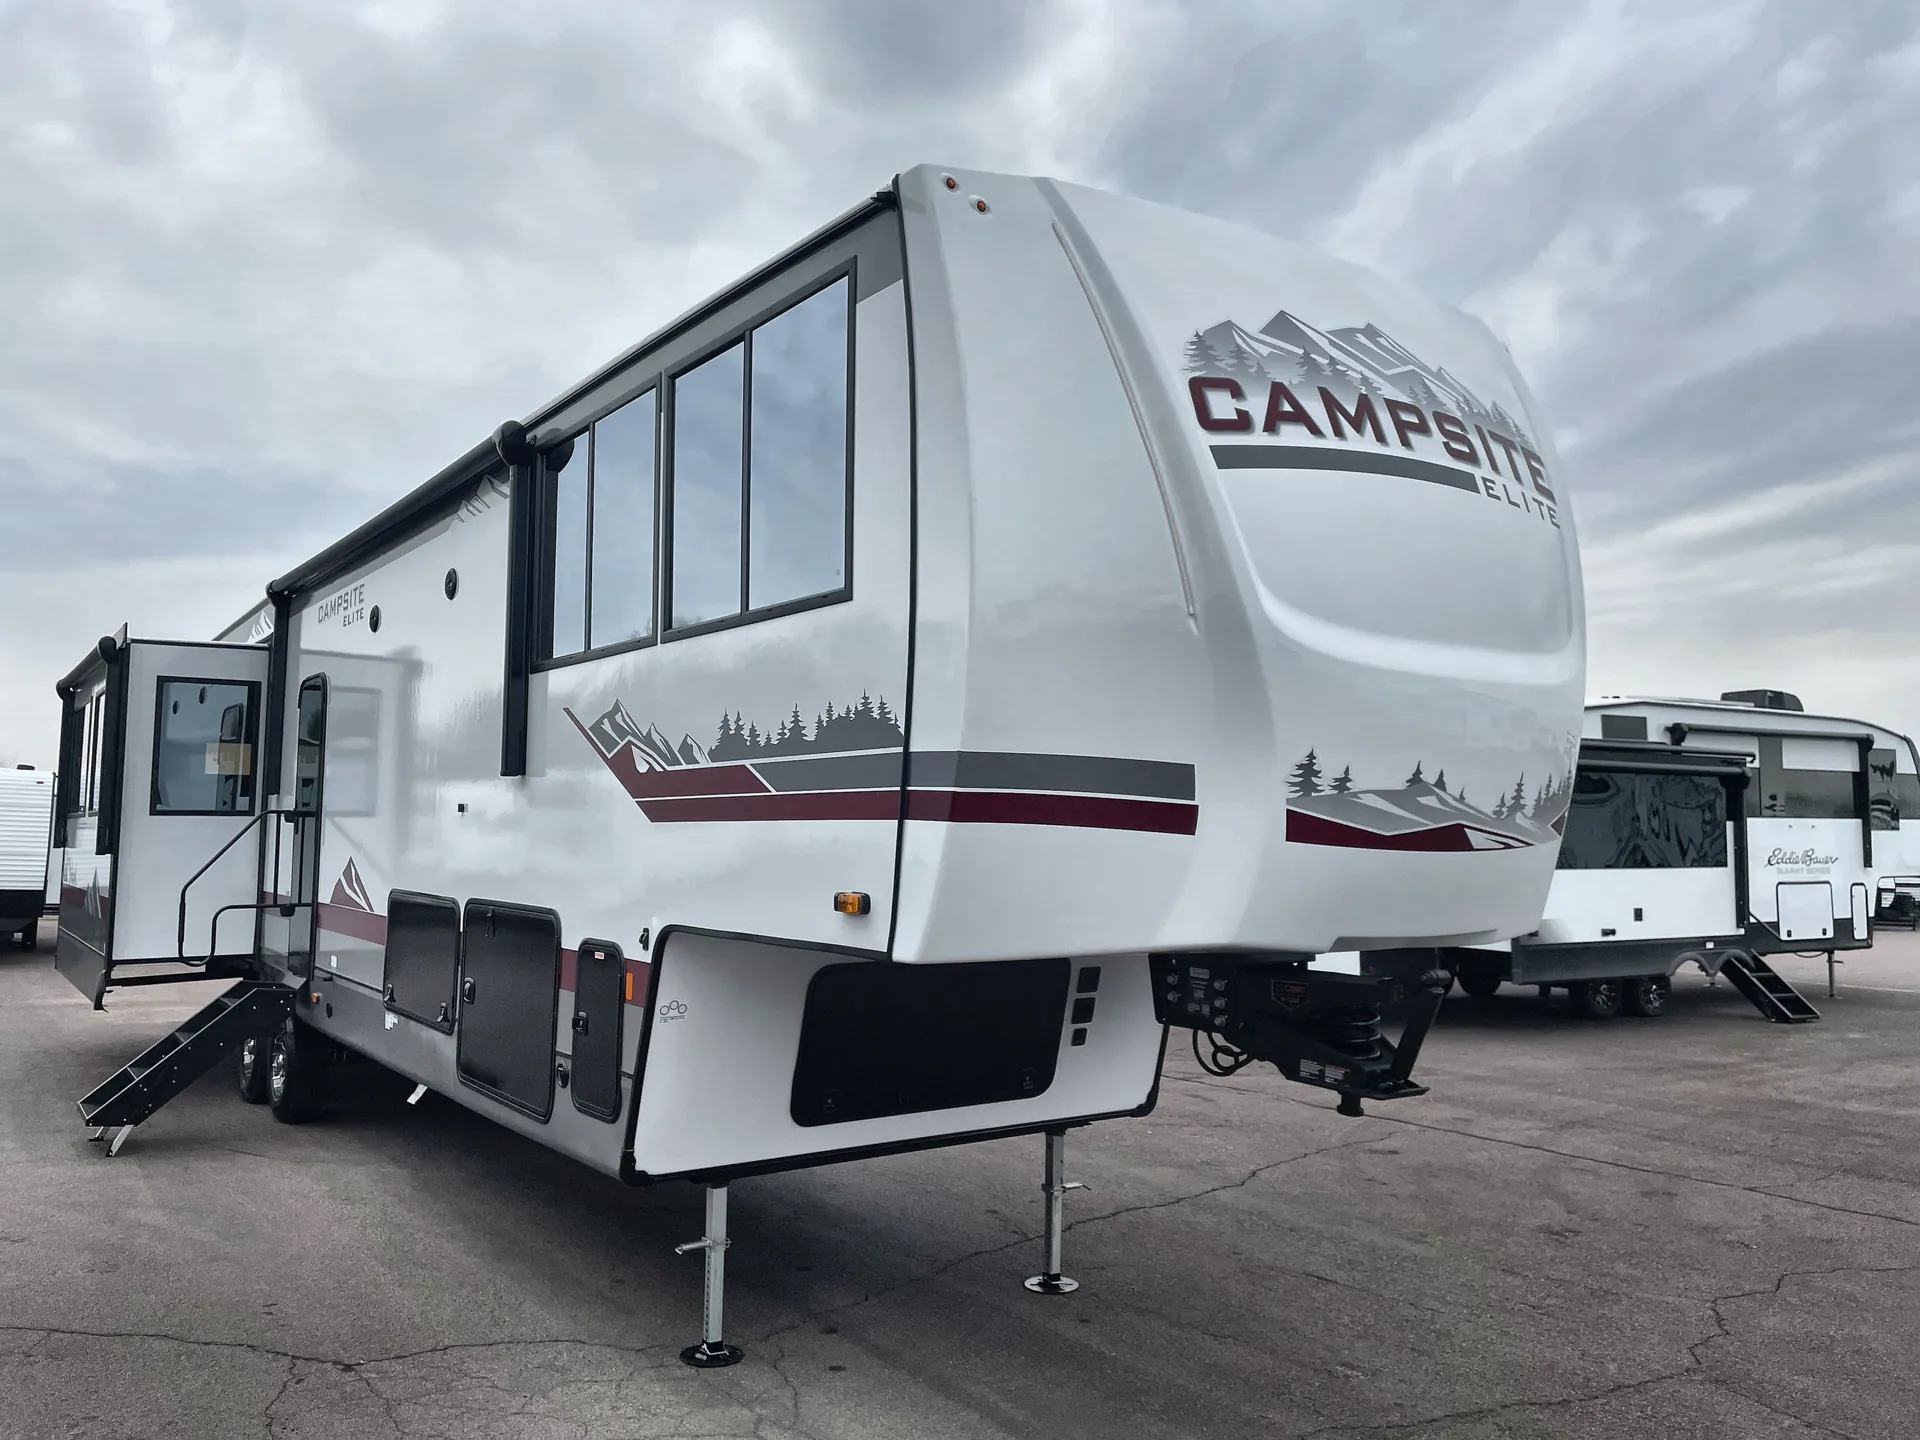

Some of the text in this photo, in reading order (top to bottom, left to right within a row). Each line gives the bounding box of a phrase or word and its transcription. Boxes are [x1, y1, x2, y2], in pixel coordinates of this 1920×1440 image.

[1188, 376, 1557, 506] CAMPSITE
[1481, 476, 1560, 529] ELITE
[318, 583, 364, 623] CAMPSITE
[343, 607, 364, 627] ELITE
[1764, 847, 1839, 868] Eddie Bauer
